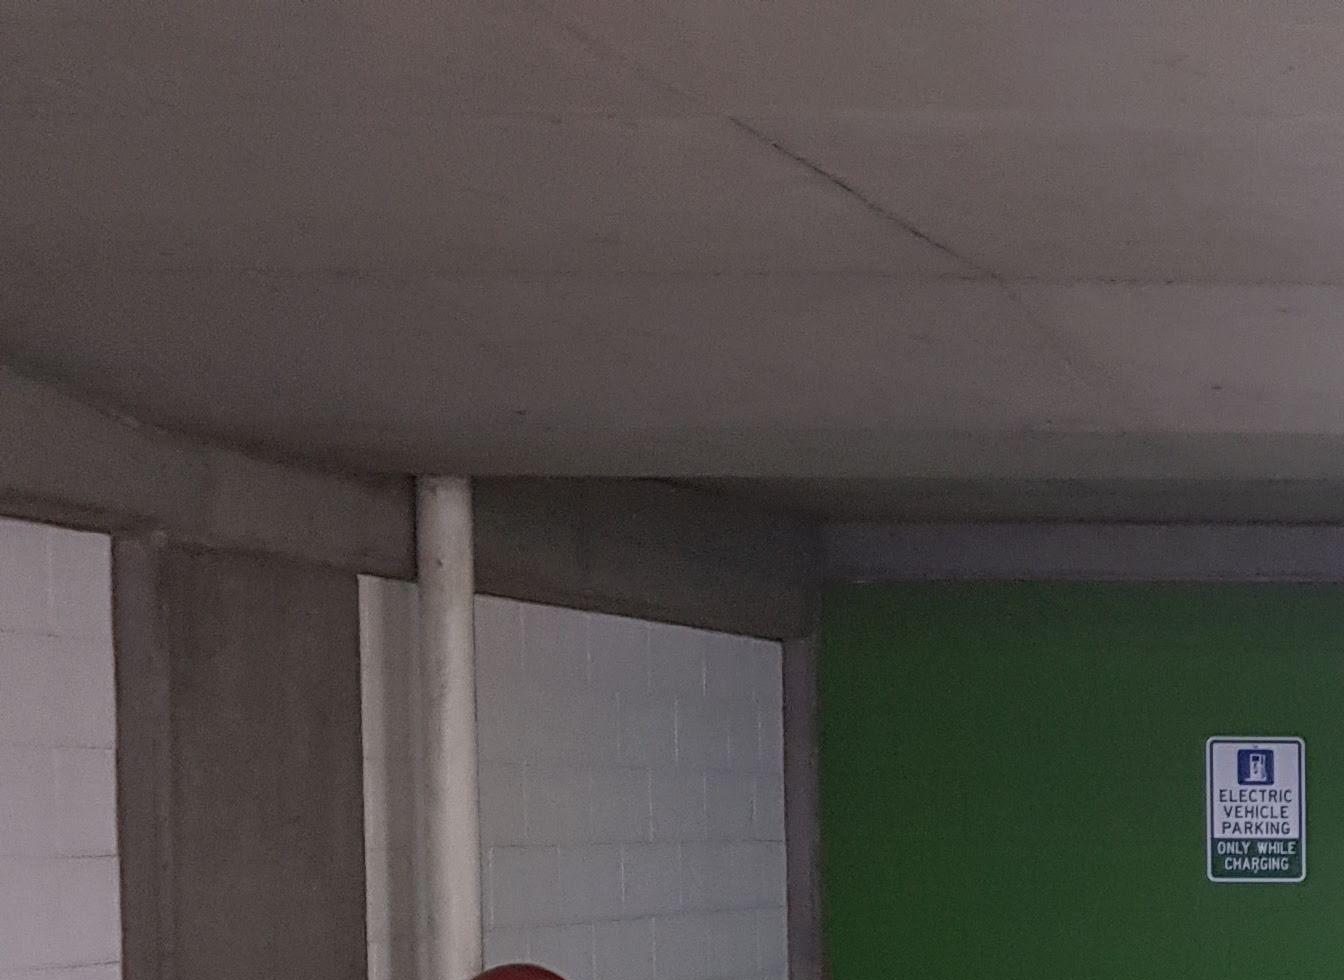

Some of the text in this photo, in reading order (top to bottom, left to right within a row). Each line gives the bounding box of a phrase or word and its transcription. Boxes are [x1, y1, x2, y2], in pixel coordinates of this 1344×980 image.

[1219, 789, 1293, 803] ELECTRIC
[1223, 805, 1289, 819] VEHICLE
[1222, 821, 1291, 835] PARKING
[1217, 841, 1296, 854] ONLY WHILE
[1224, 857, 1289, 871] CHARGING
